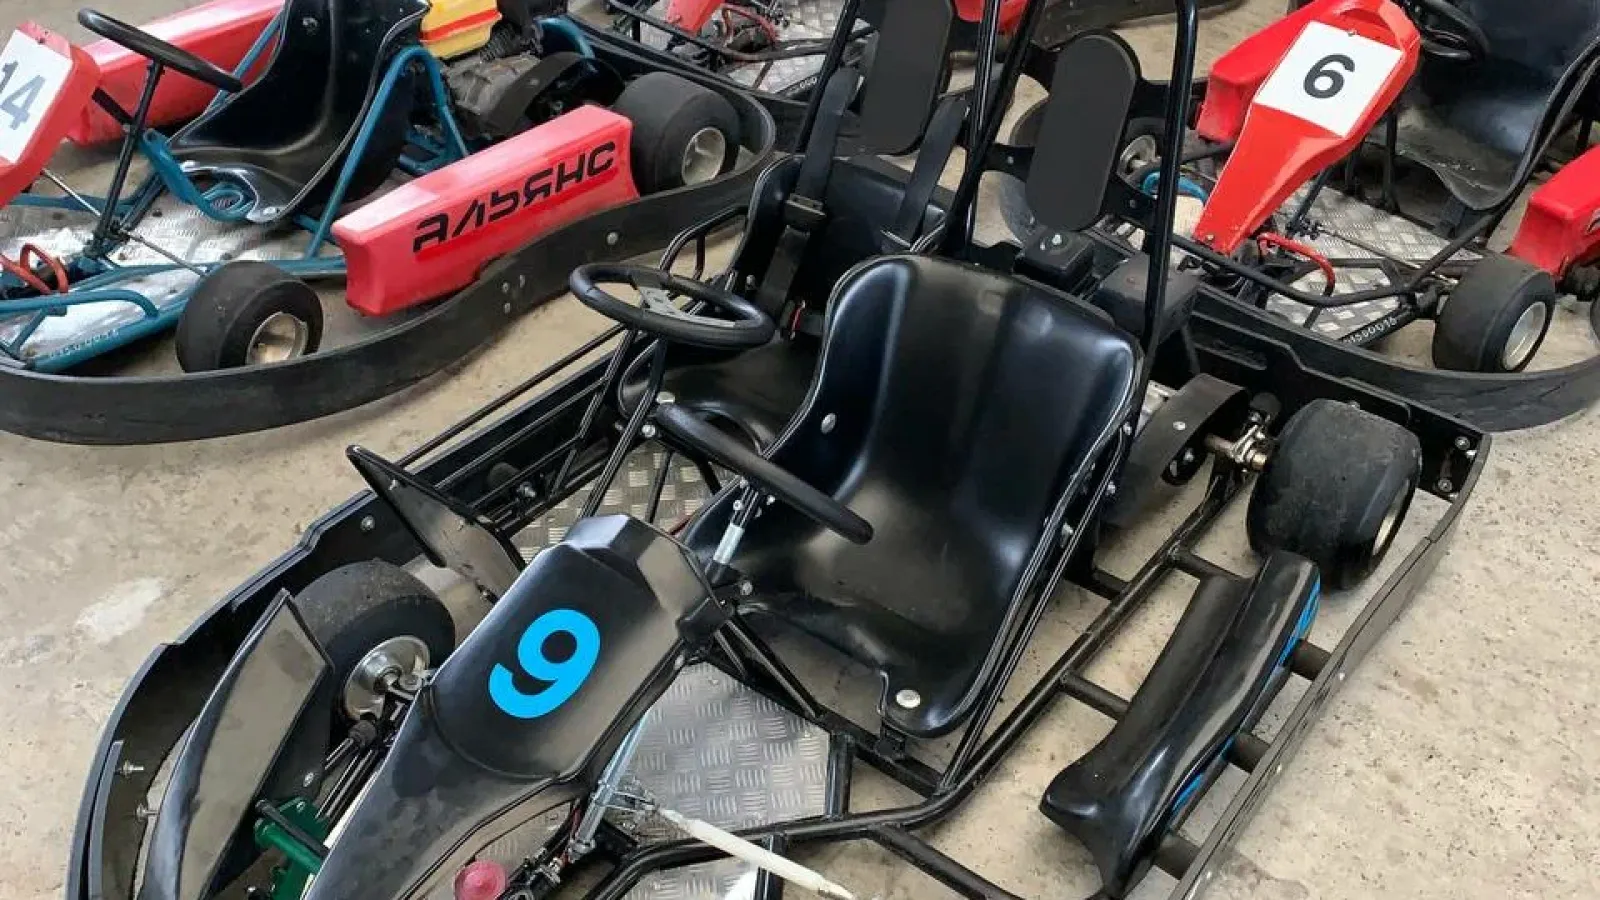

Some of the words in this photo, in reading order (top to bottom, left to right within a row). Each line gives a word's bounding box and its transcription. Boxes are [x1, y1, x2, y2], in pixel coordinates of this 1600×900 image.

[0, 60, 46, 131] 14
[1303, 53, 1356, 99] 6
[412, 140, 617, 253] АЛЬЯНС
[488, 608, 601, 719] 9
